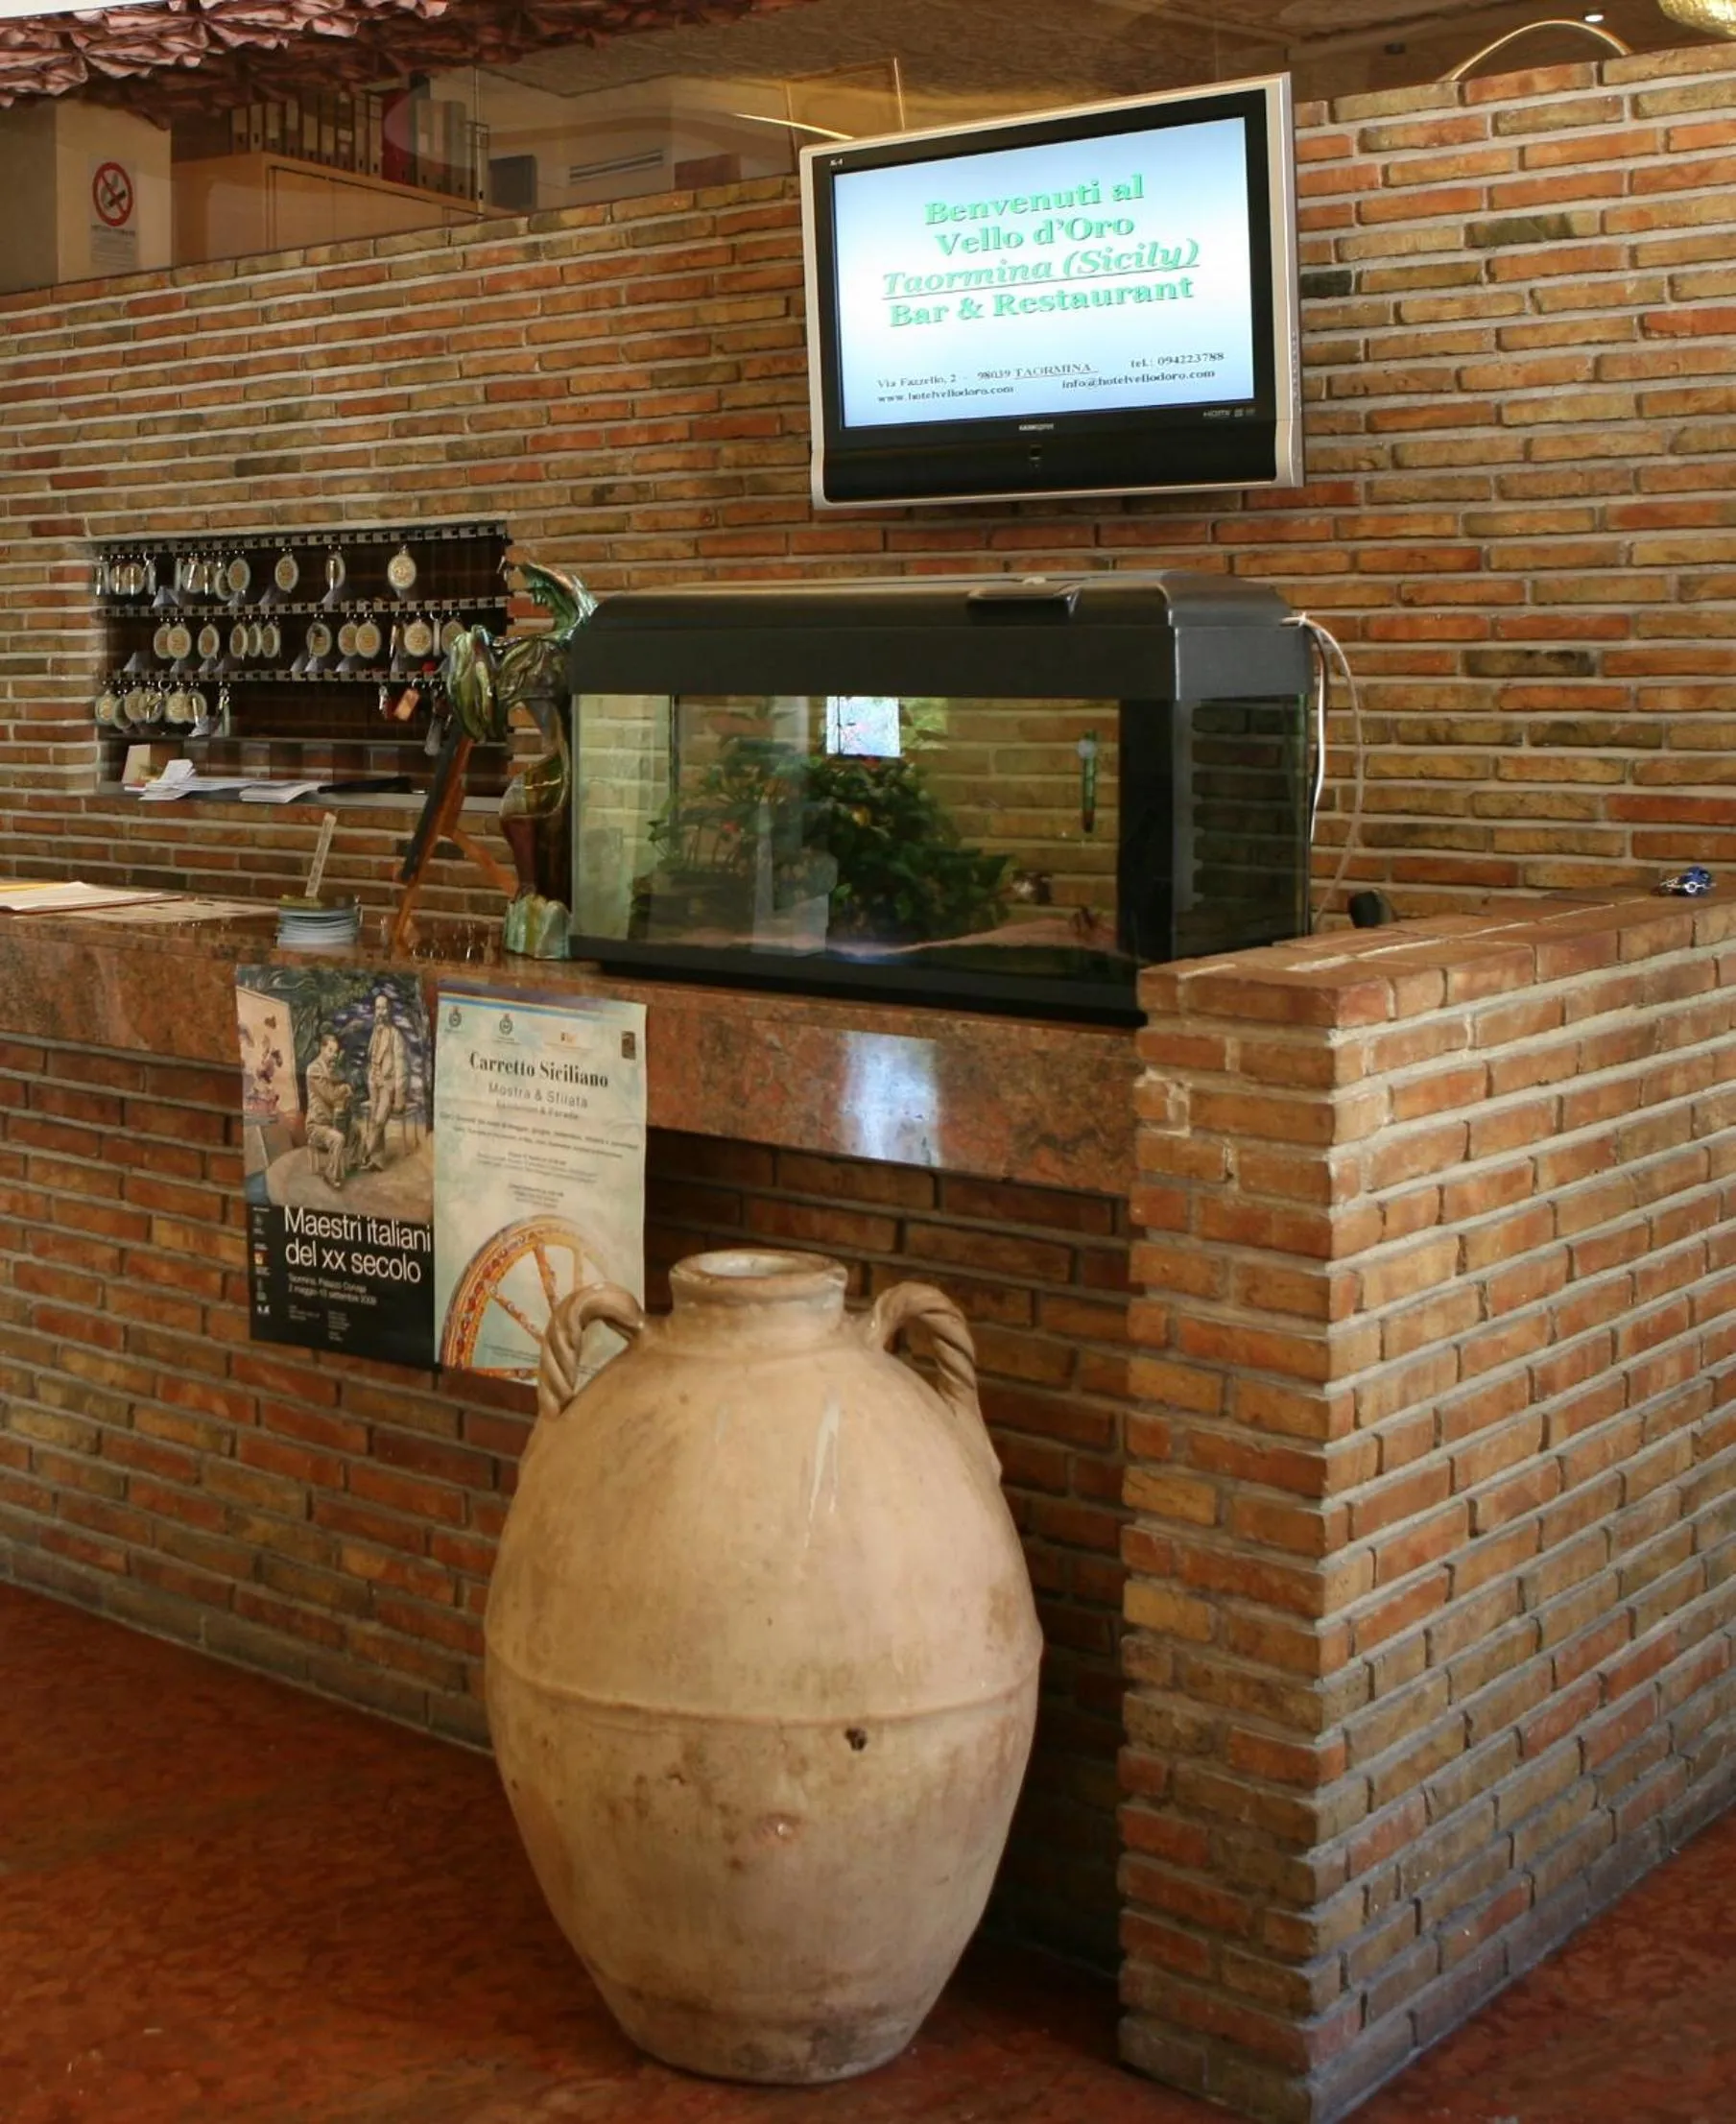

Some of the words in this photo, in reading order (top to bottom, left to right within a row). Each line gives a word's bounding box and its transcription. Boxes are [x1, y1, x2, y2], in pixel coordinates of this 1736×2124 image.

[924, 179, 1102, 226] Benvenuti
[1111, 173, 1145, 202] al
[934, 226, 1024, 256] Vello
[1033, 217, 1135, 246] d'Oro
[882, 257, 1054, 296] Taormina
[1062, 237, 1200, 278] (Sicily)
[890, 303, 949, 327] Bar
[957, 297, 985, 321] &
[992, 276, 1195, 317] Restaurant
[1014, 363, 1092, 379] TAORMINA
[1157, 351, 1225, 367] 094223788
[1061, 370, 1216, 390] info@hotelvellodoro.com
[469, 1051, 535, 1078] Carretto
[539, 1060, 609, 1088] Siciliano
[488, 1082, 531, 1100] Mostra
[535, 1088, 543, 1102] &
[284, 1205, 362, 1242] Maestri
[366, 1216, 432, 1253] italiani
[285, 1237, 317, 1267] del
[350, 1253, 421, 1283] secolo
